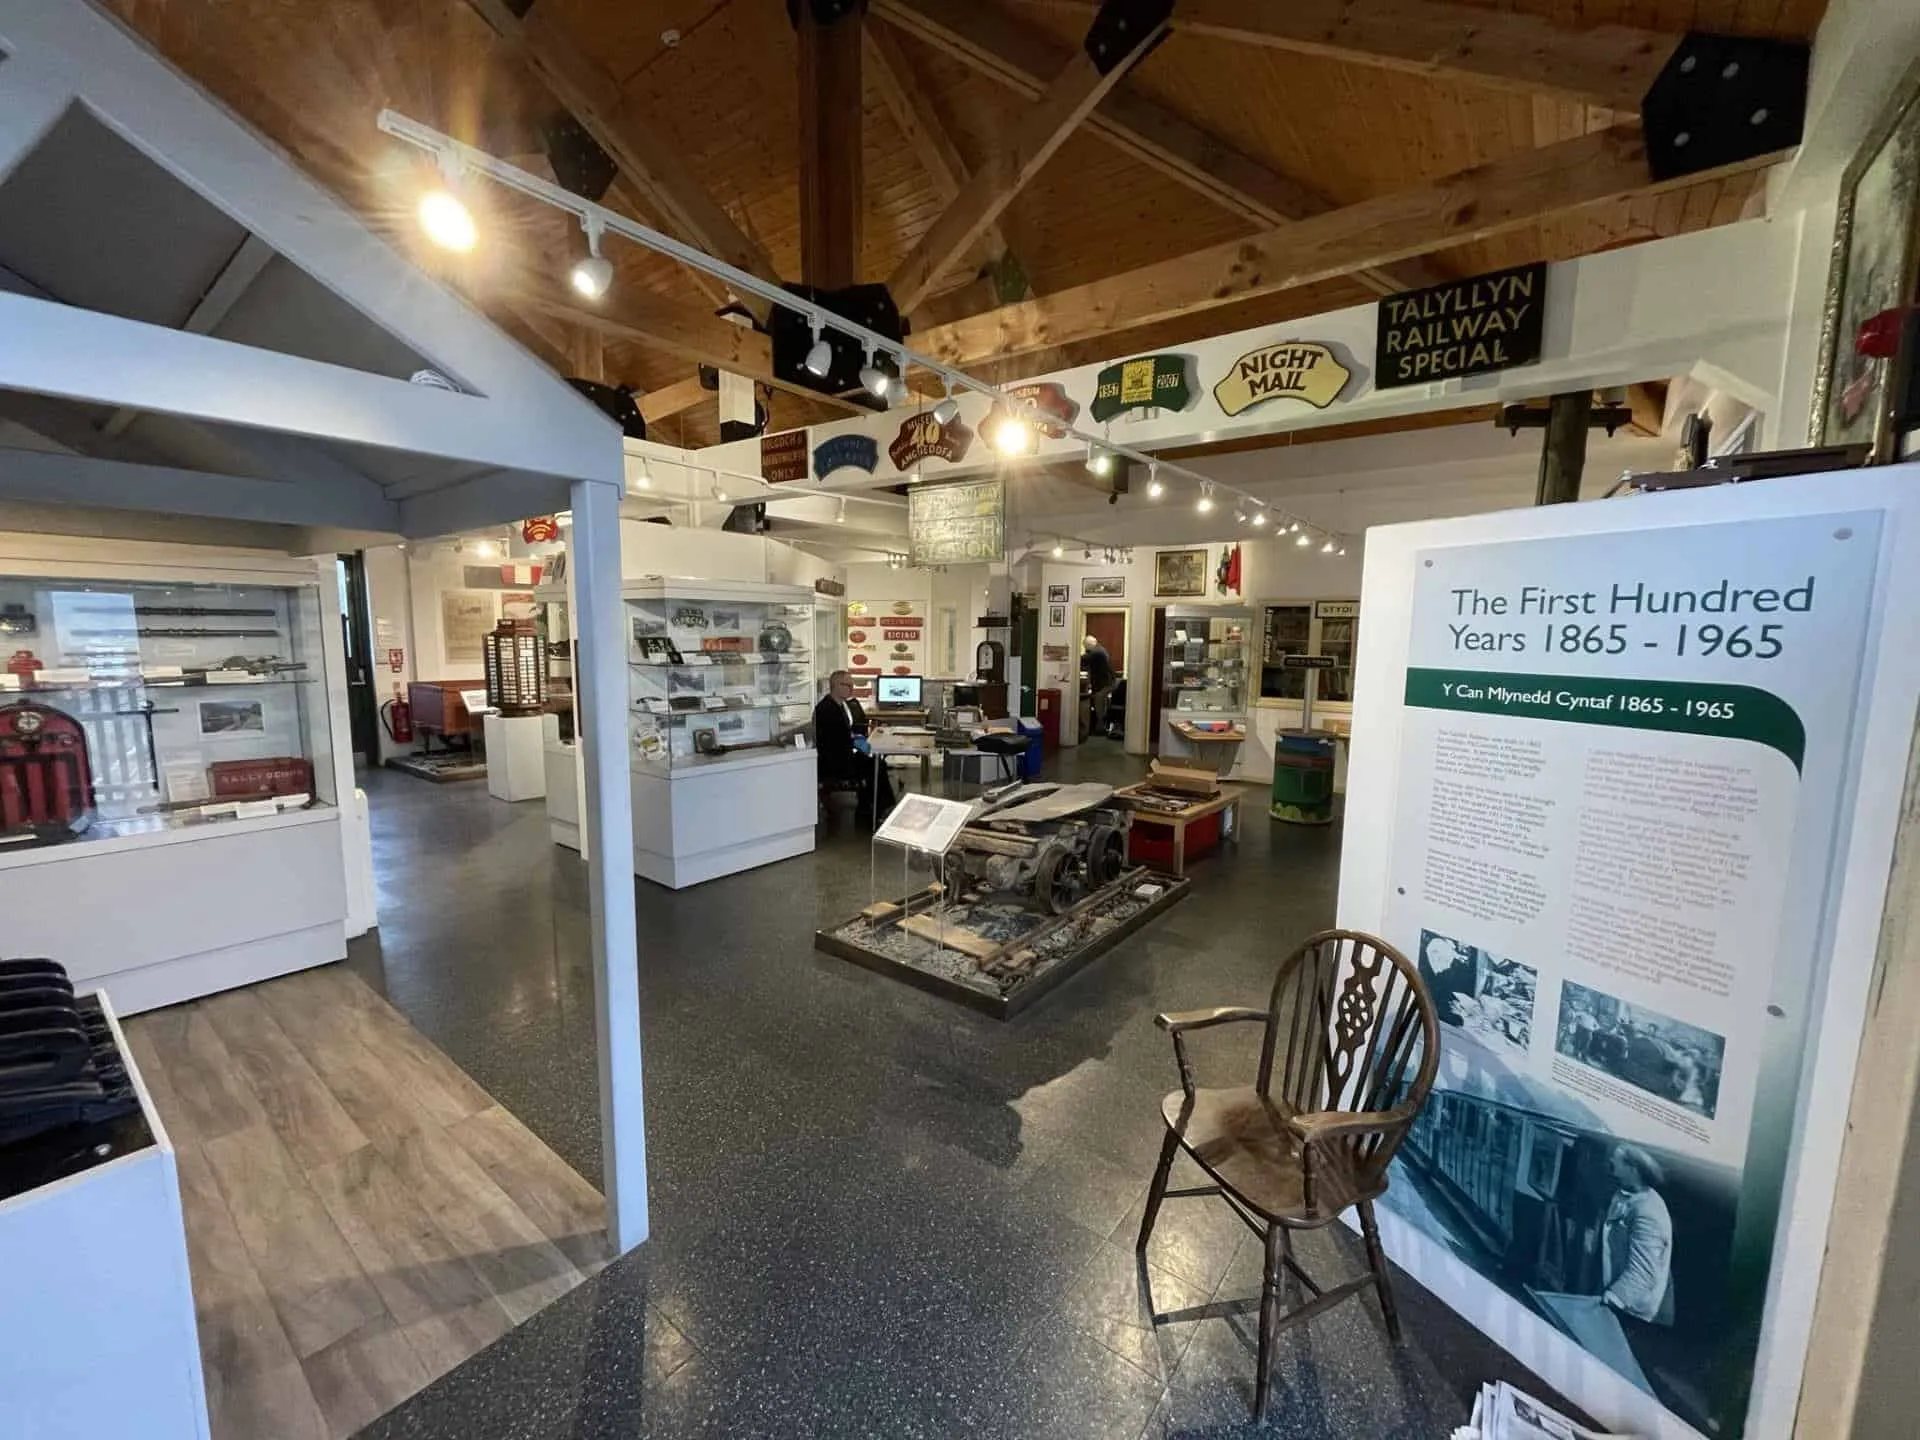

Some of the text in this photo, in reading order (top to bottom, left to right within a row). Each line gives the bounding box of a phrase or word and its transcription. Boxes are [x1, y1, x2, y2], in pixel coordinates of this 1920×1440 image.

[1387, 272, 1534, 325] TALYLLYN
[1386, 303, 1530, 353] RAILWAY
[1240, 348, 1323, 380] NIGHT
[1398, 339, 1509, 379] SPECIAL
[1156, 373, 1180, 389] 2007
[1248, 371, 1306, 398] MAIL
[907, 414, 935, 430] MUSE
[1451, 576, 1815, 617] The First Hundred
[1449, 623, 1526, 653] Years
[1545, 622, 1627, 655] 1865
[1676, 622, 1784, 660] 1965
[1442, 682, 1454, 697] Y
[1456, 684, 1484, 700] Can
[1487, 685, 1551, 706] Mlynedd
[1556, 691, 1615, 714] Cyntaf
[1619, 695, 1664, 714] 1865
[1685, 700, 1735, 720] 1965
